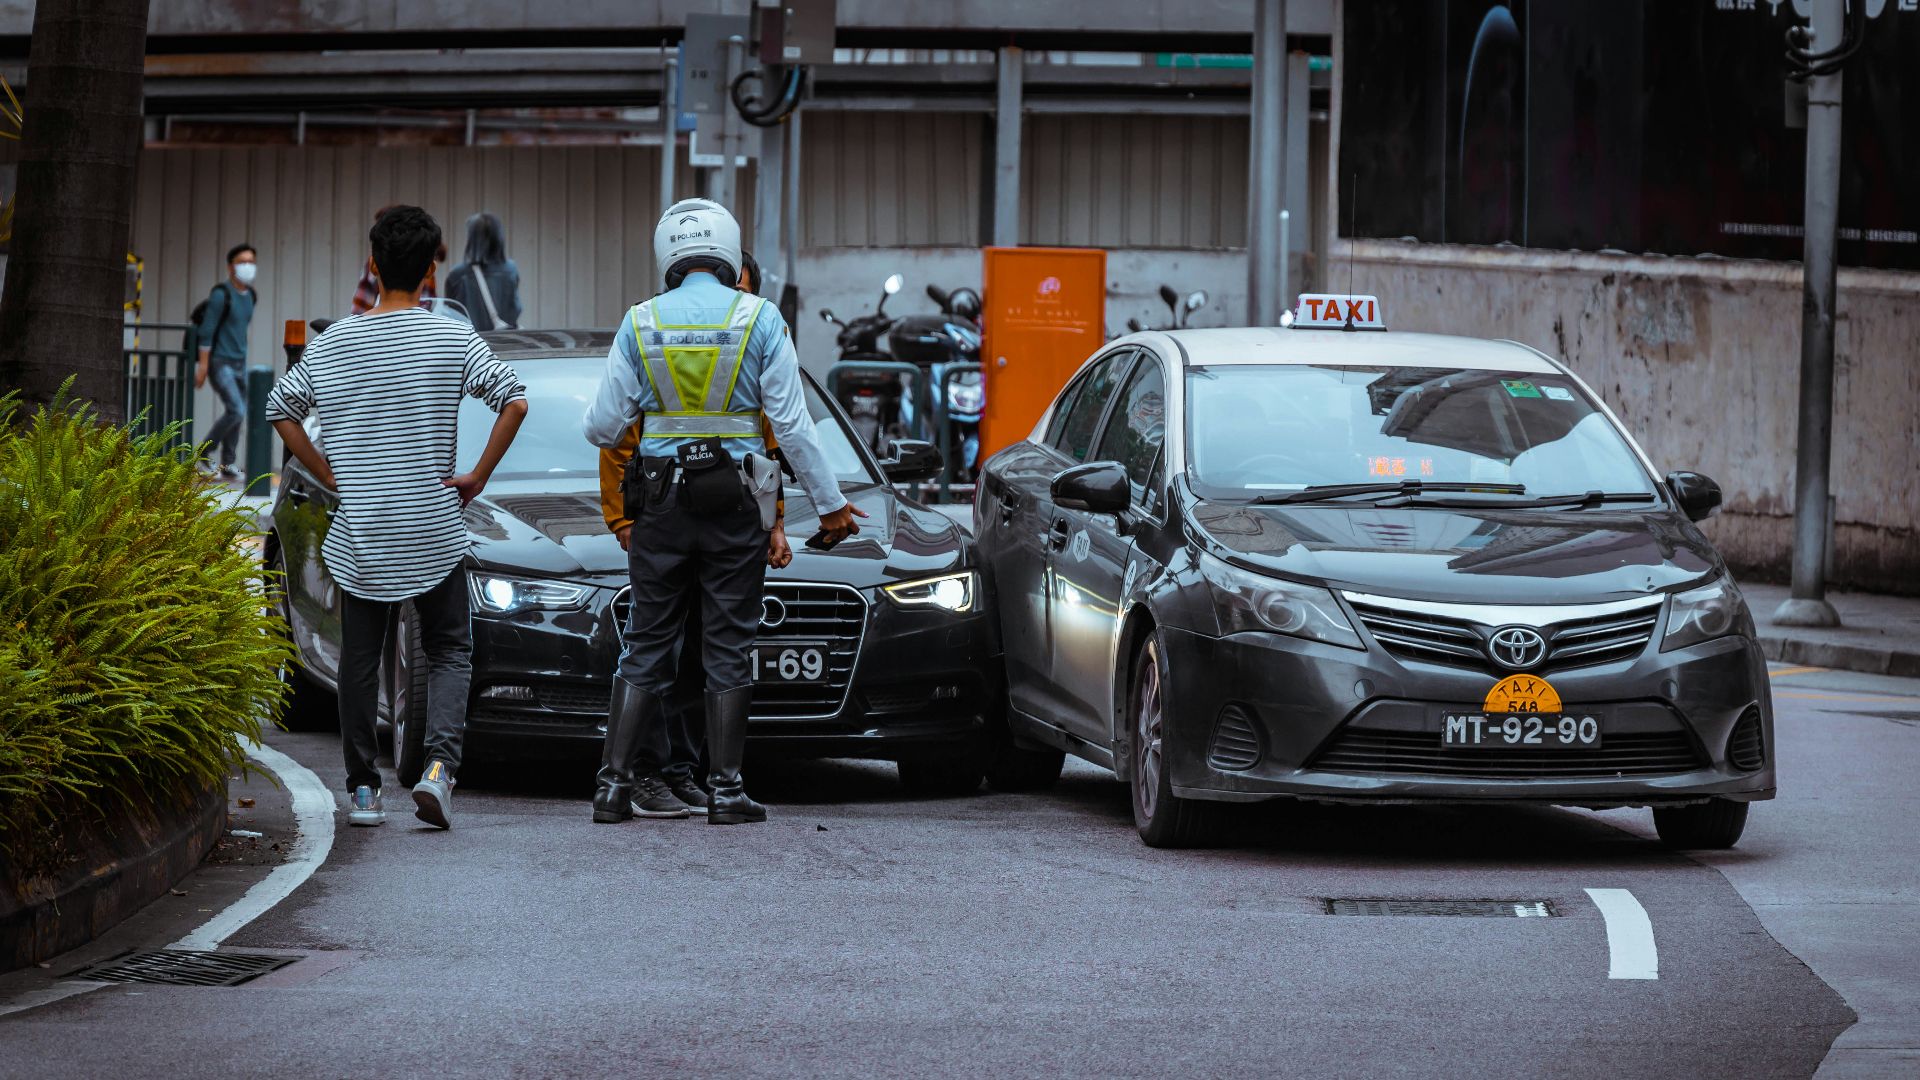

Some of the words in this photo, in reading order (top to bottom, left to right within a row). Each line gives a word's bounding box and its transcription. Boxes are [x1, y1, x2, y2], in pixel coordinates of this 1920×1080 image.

[1306, 299, 1374, 322] TAXI
[749, 649, 823, 680] 1-69
[1498, 680, 1546, 698] TAXI
[1508, 701, 1538, 712] 548
[1446, 716, 1598, 744] MT-92-90
